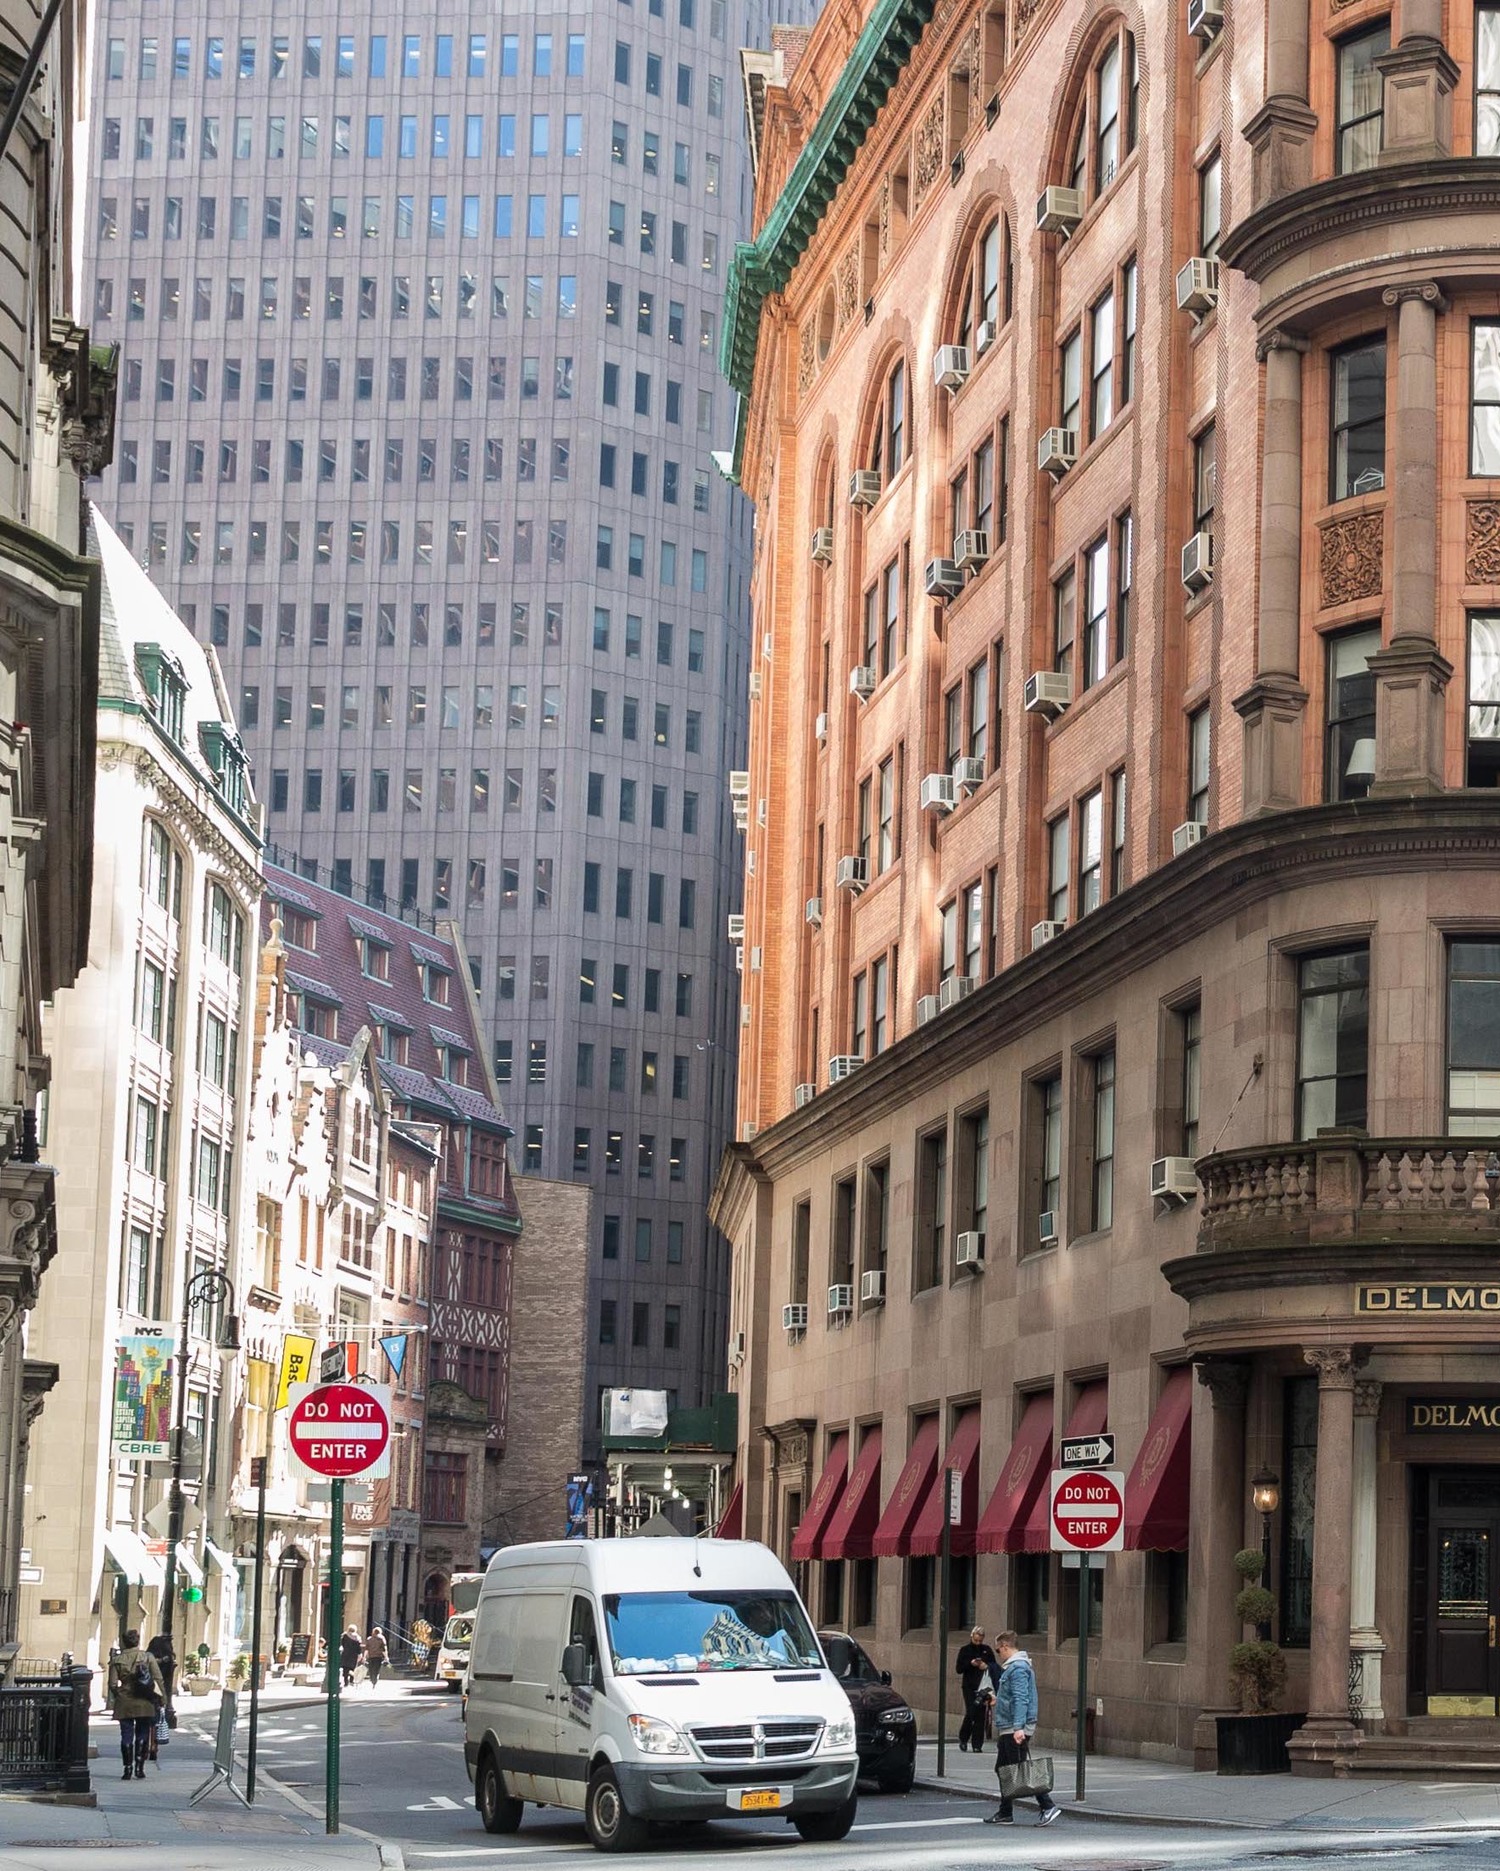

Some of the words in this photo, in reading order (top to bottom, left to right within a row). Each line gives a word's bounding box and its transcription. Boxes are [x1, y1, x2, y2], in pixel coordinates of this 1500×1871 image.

[135, 1326, 163, 1337] NYC
[286, 1353, 304, 1389] Bas
[619, 1394, 630, 1403] 44
[305, 1402, 329, 1418] DO
[340, 1403, 375, 1418] NOT
[119, 1443, 163, 1454] CBRE
[311, 1444, 367, 1459] ENTER
[1066, 1447, 1082, 1460] ONE
[1085, 1445, 1101, 1458] WAY
[1065, 1487, 1082, 1500] DO
[1086, 1487, 1110, 1500] NOT
[352, 1504, 374, 1514] FINE
[624, 1507, 642, 1516] MILL
[1068, 1521, 1108, 1535] ENTER
